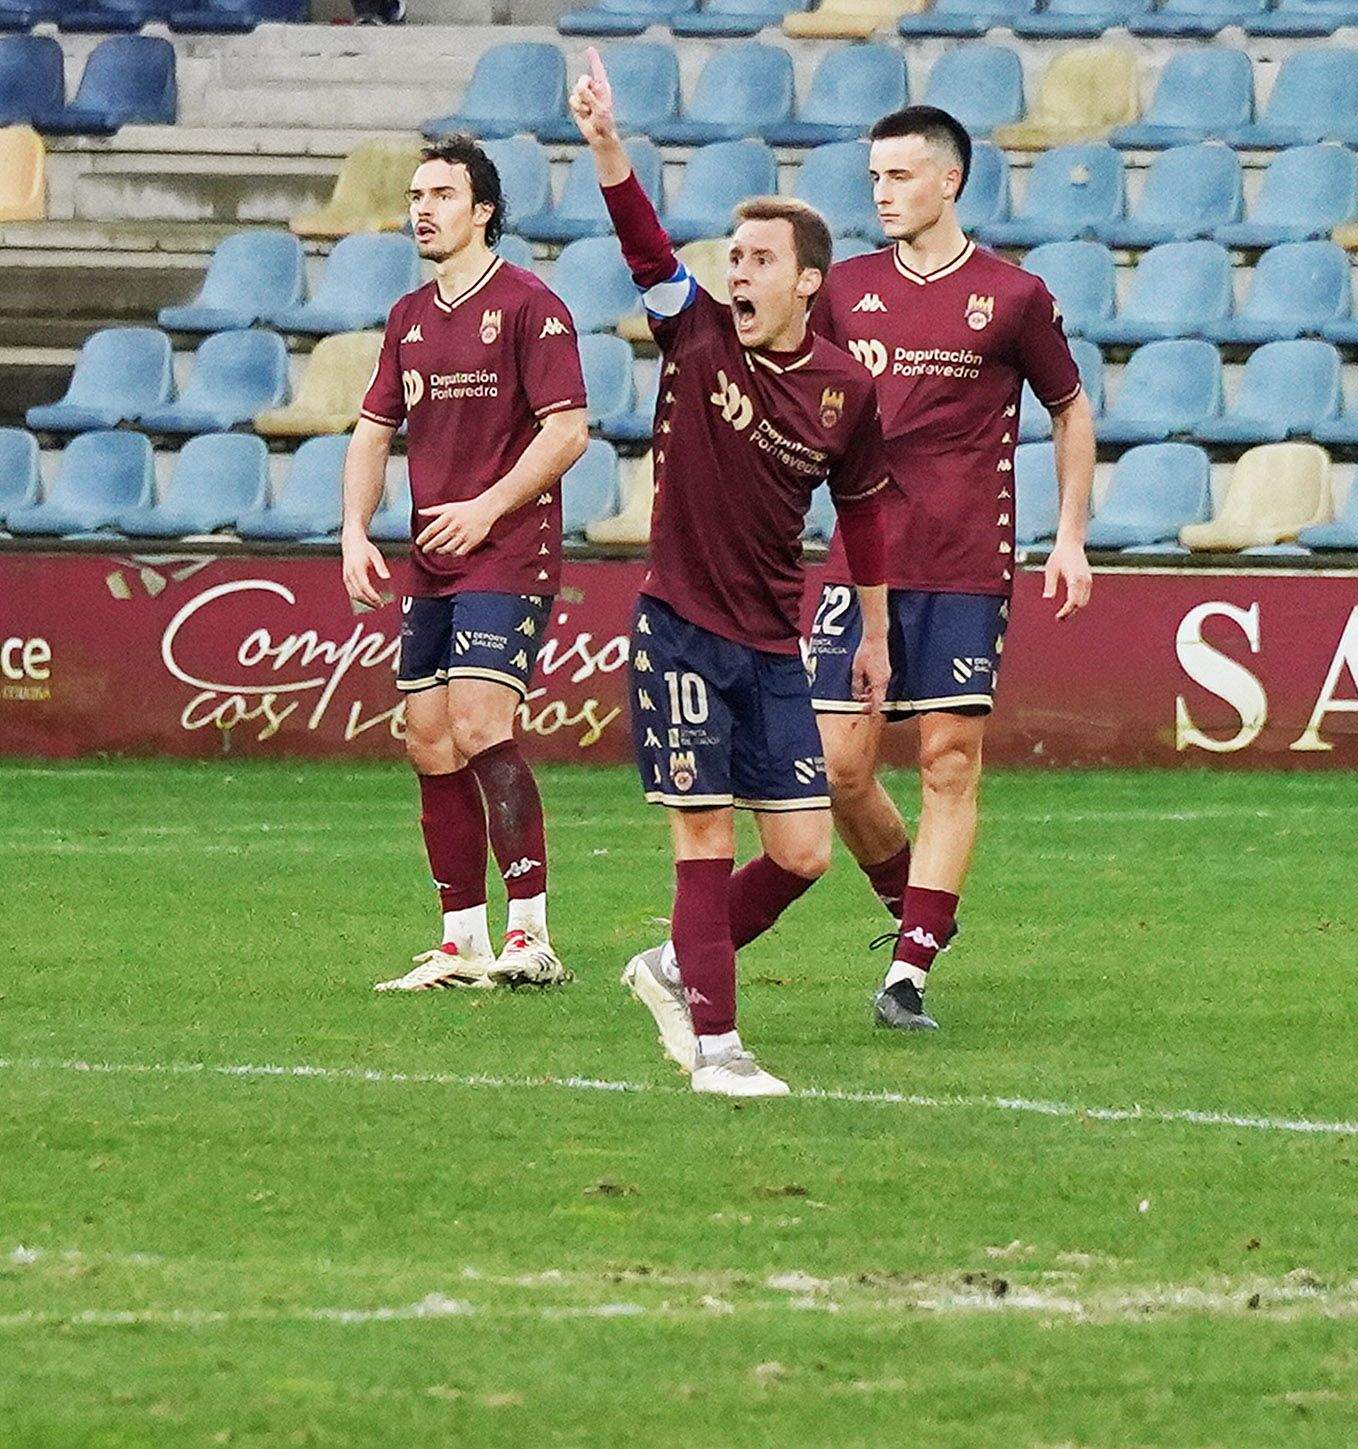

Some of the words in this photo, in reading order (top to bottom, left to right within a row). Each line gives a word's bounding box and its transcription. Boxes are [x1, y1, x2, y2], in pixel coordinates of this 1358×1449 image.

[892, 362, 980, 379] Pontevedra
[894, 346, 983, 366] Deputación
[180, 691, 299, 741] cos
[664, 672, 709, 725] 10
